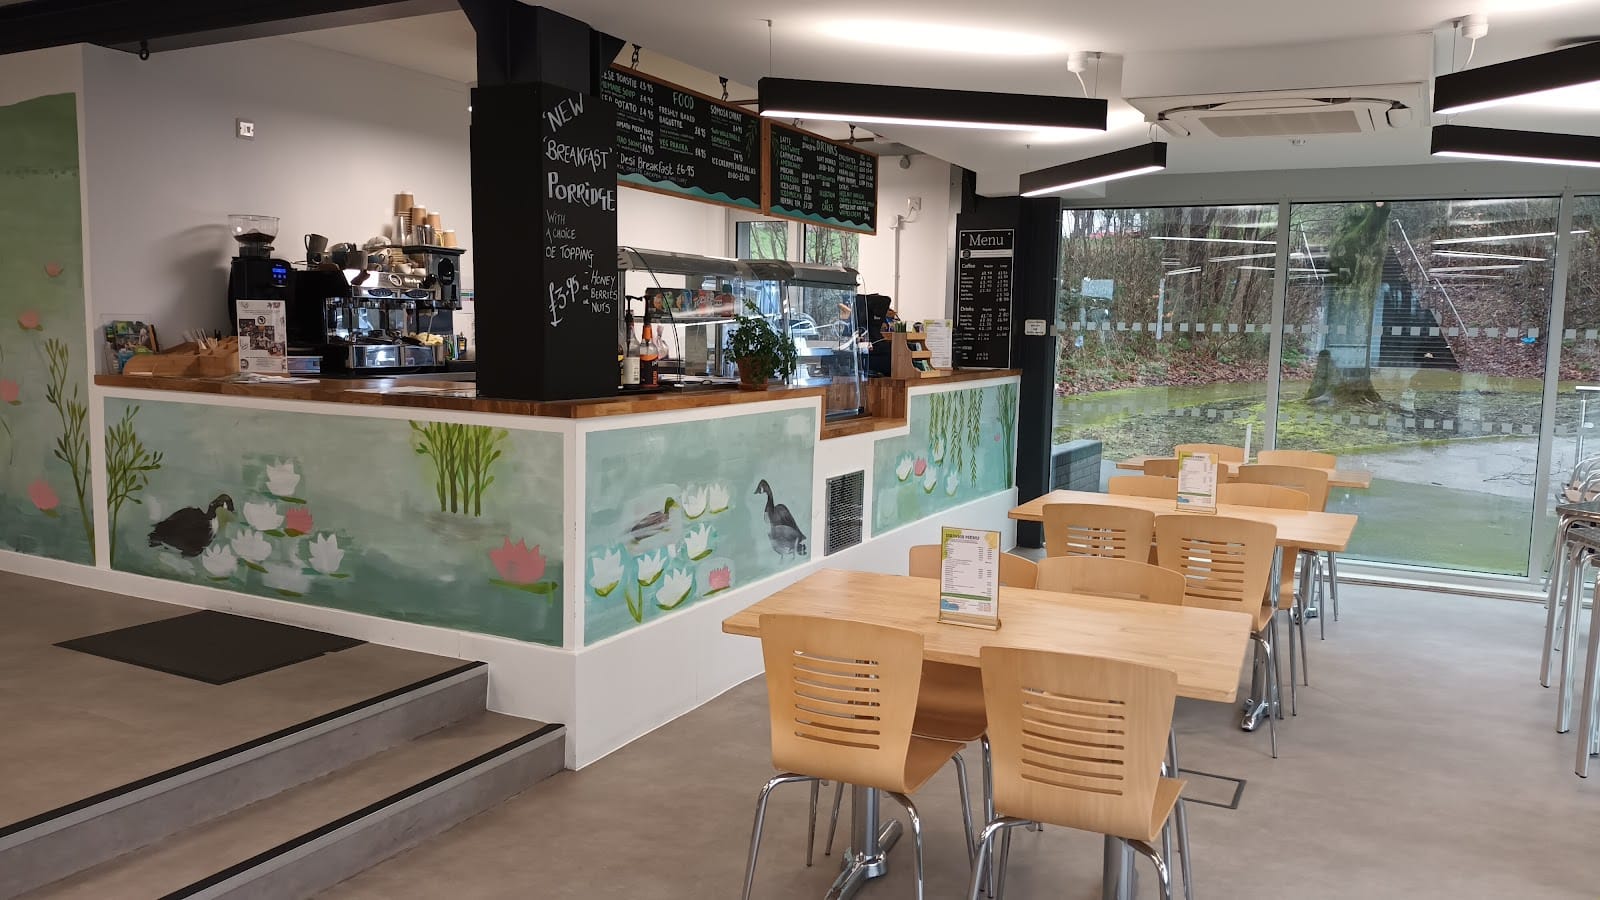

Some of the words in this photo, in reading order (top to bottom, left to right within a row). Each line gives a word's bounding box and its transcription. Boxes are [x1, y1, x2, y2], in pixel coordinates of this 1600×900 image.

[616, 73, 638, 89] TOASTIE
[673, 91, 694, 110] FOOD
[615, 98, 638, 113] POTATO
[640, 107, 654, 120] £4.95
[780, 135, 791, 146] LATTE
[816, 141, 838, 157] DRINKS
[620, 152, 636, 167] Desi
[637, 156, 675, 176] Breakfast
[676, 163, 695, 178] £6.95
[546, 209, 567, 225] WITH
[553, 227, 577, 240] CHOICE
[969, 234, 1005, 247] Menu
[560, 244, 594, 268] TOPPING
[590, 269, 616, 291] HONEY
[590, 287, 618, 301] BERRIES
[591, 302, 612, 314] NUTS
